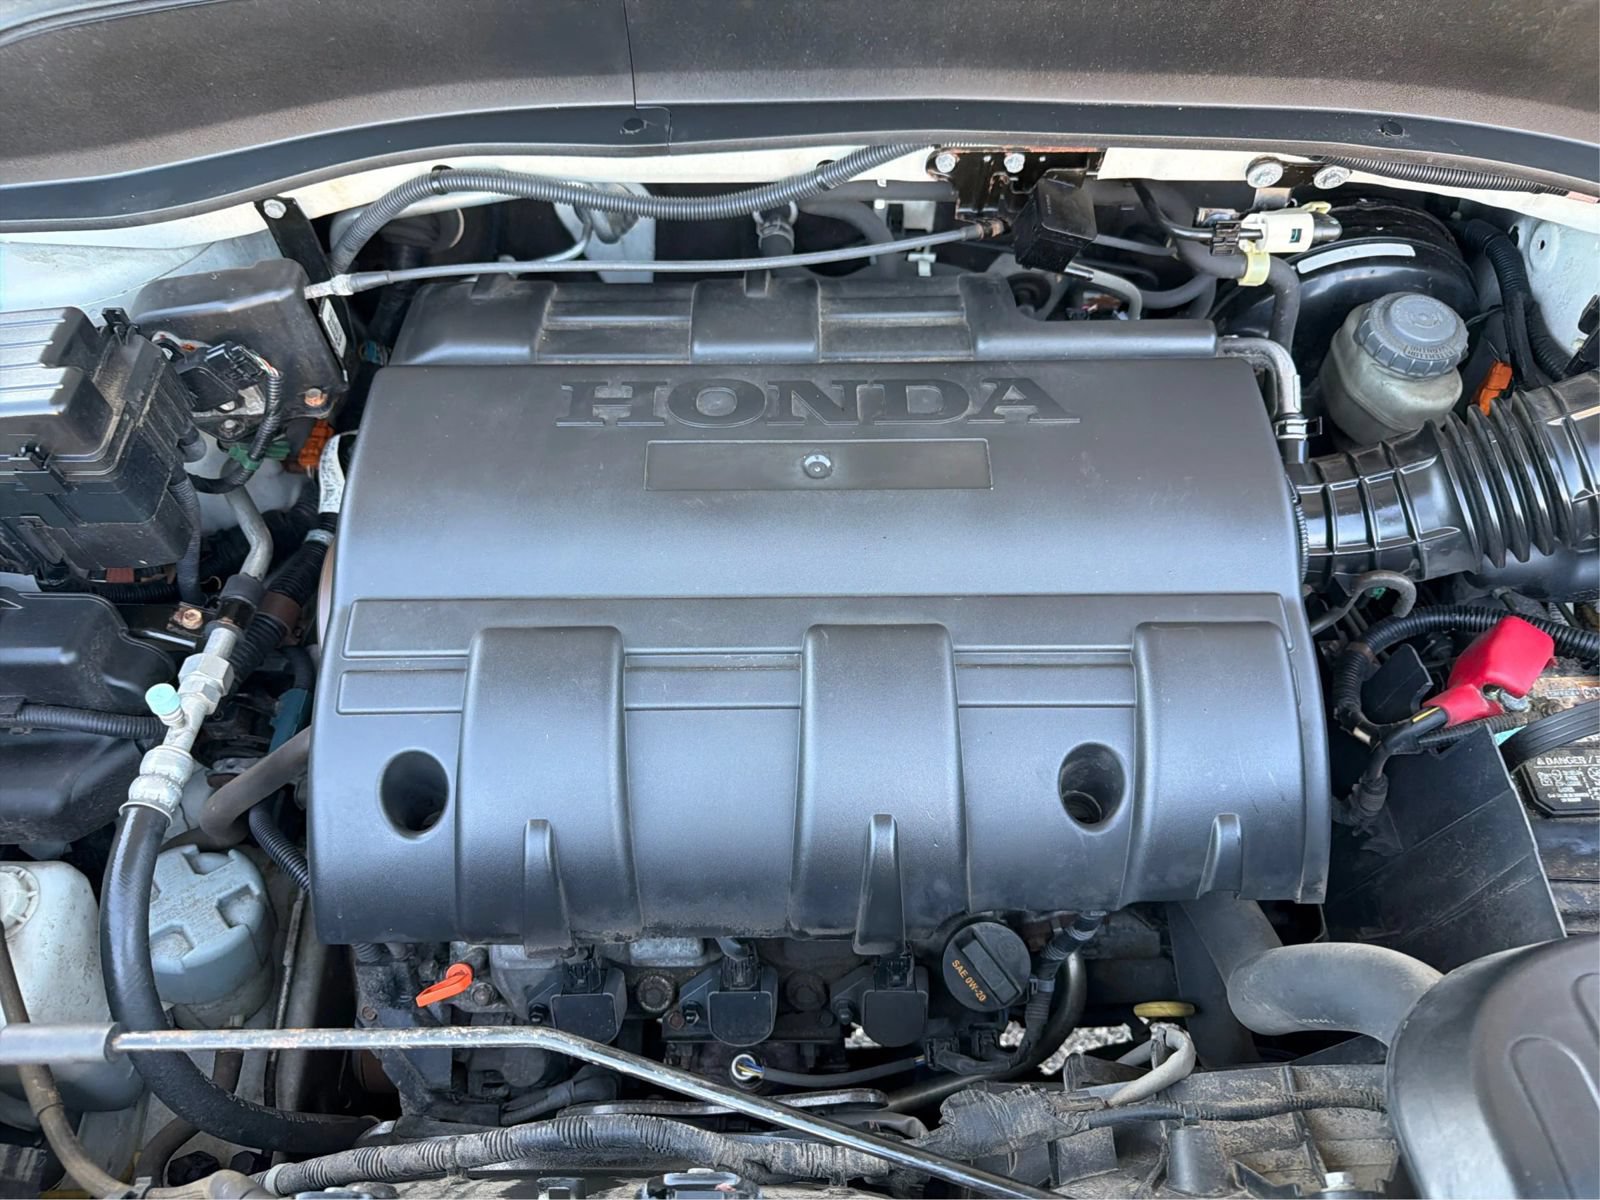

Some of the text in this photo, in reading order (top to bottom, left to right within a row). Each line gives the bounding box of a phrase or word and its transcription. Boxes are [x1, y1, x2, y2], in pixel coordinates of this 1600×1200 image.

[556, 377, 1081, 428] HONDA
[1545, 755, 1587, 765] DANGER
[952, 959, 987, 1002] SAE 0W-20
